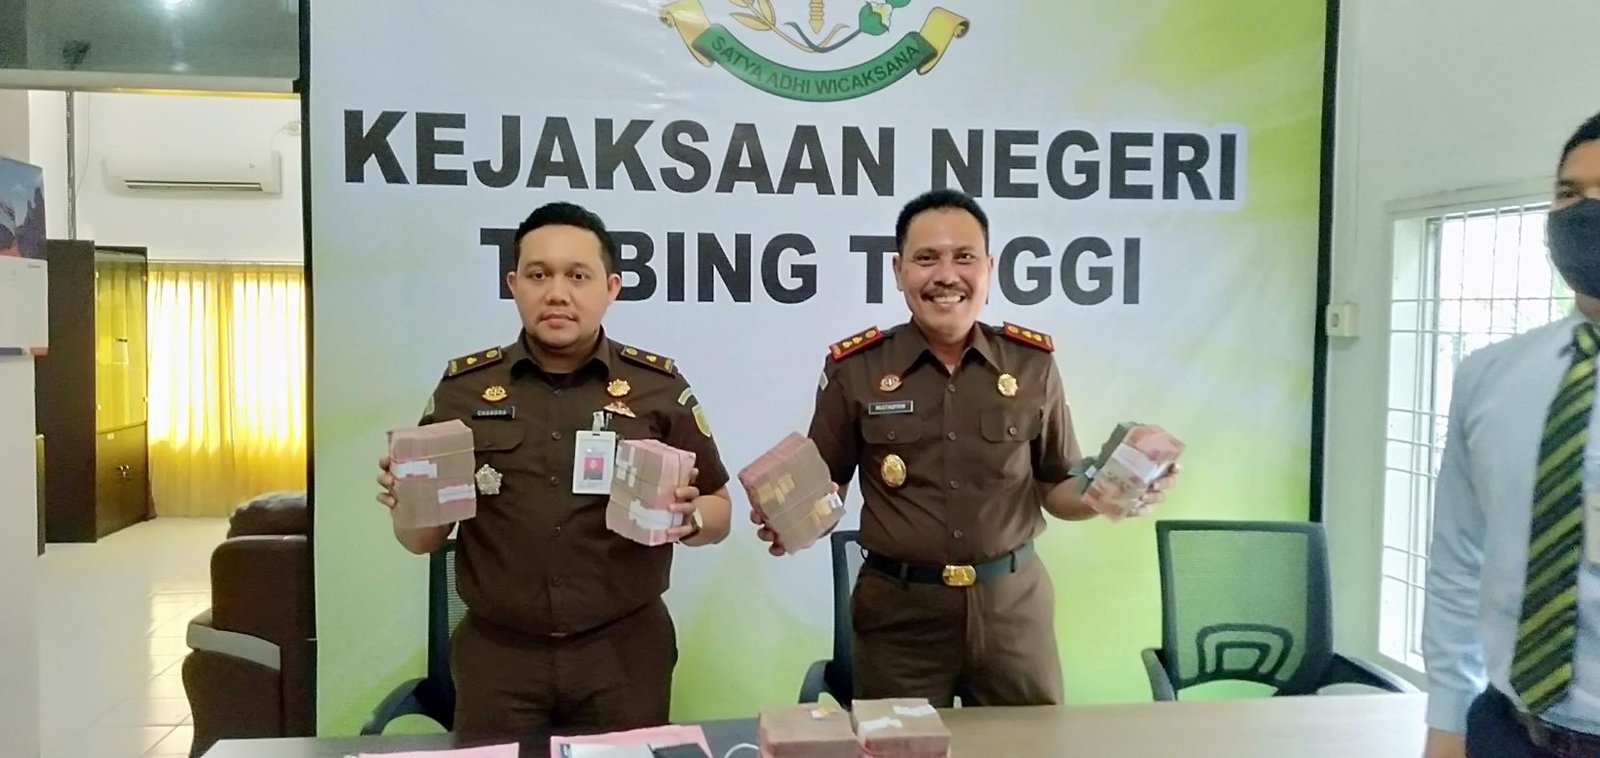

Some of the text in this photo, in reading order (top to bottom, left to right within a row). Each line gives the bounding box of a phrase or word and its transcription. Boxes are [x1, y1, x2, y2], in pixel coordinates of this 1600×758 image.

[711, 36, 920, 96] SATYA ADHI WICAKSANA
[343, 110, 1237, 201] KEJAKSAAN NEGERI
[480, 227, 1141, 306] TBING TGGI
